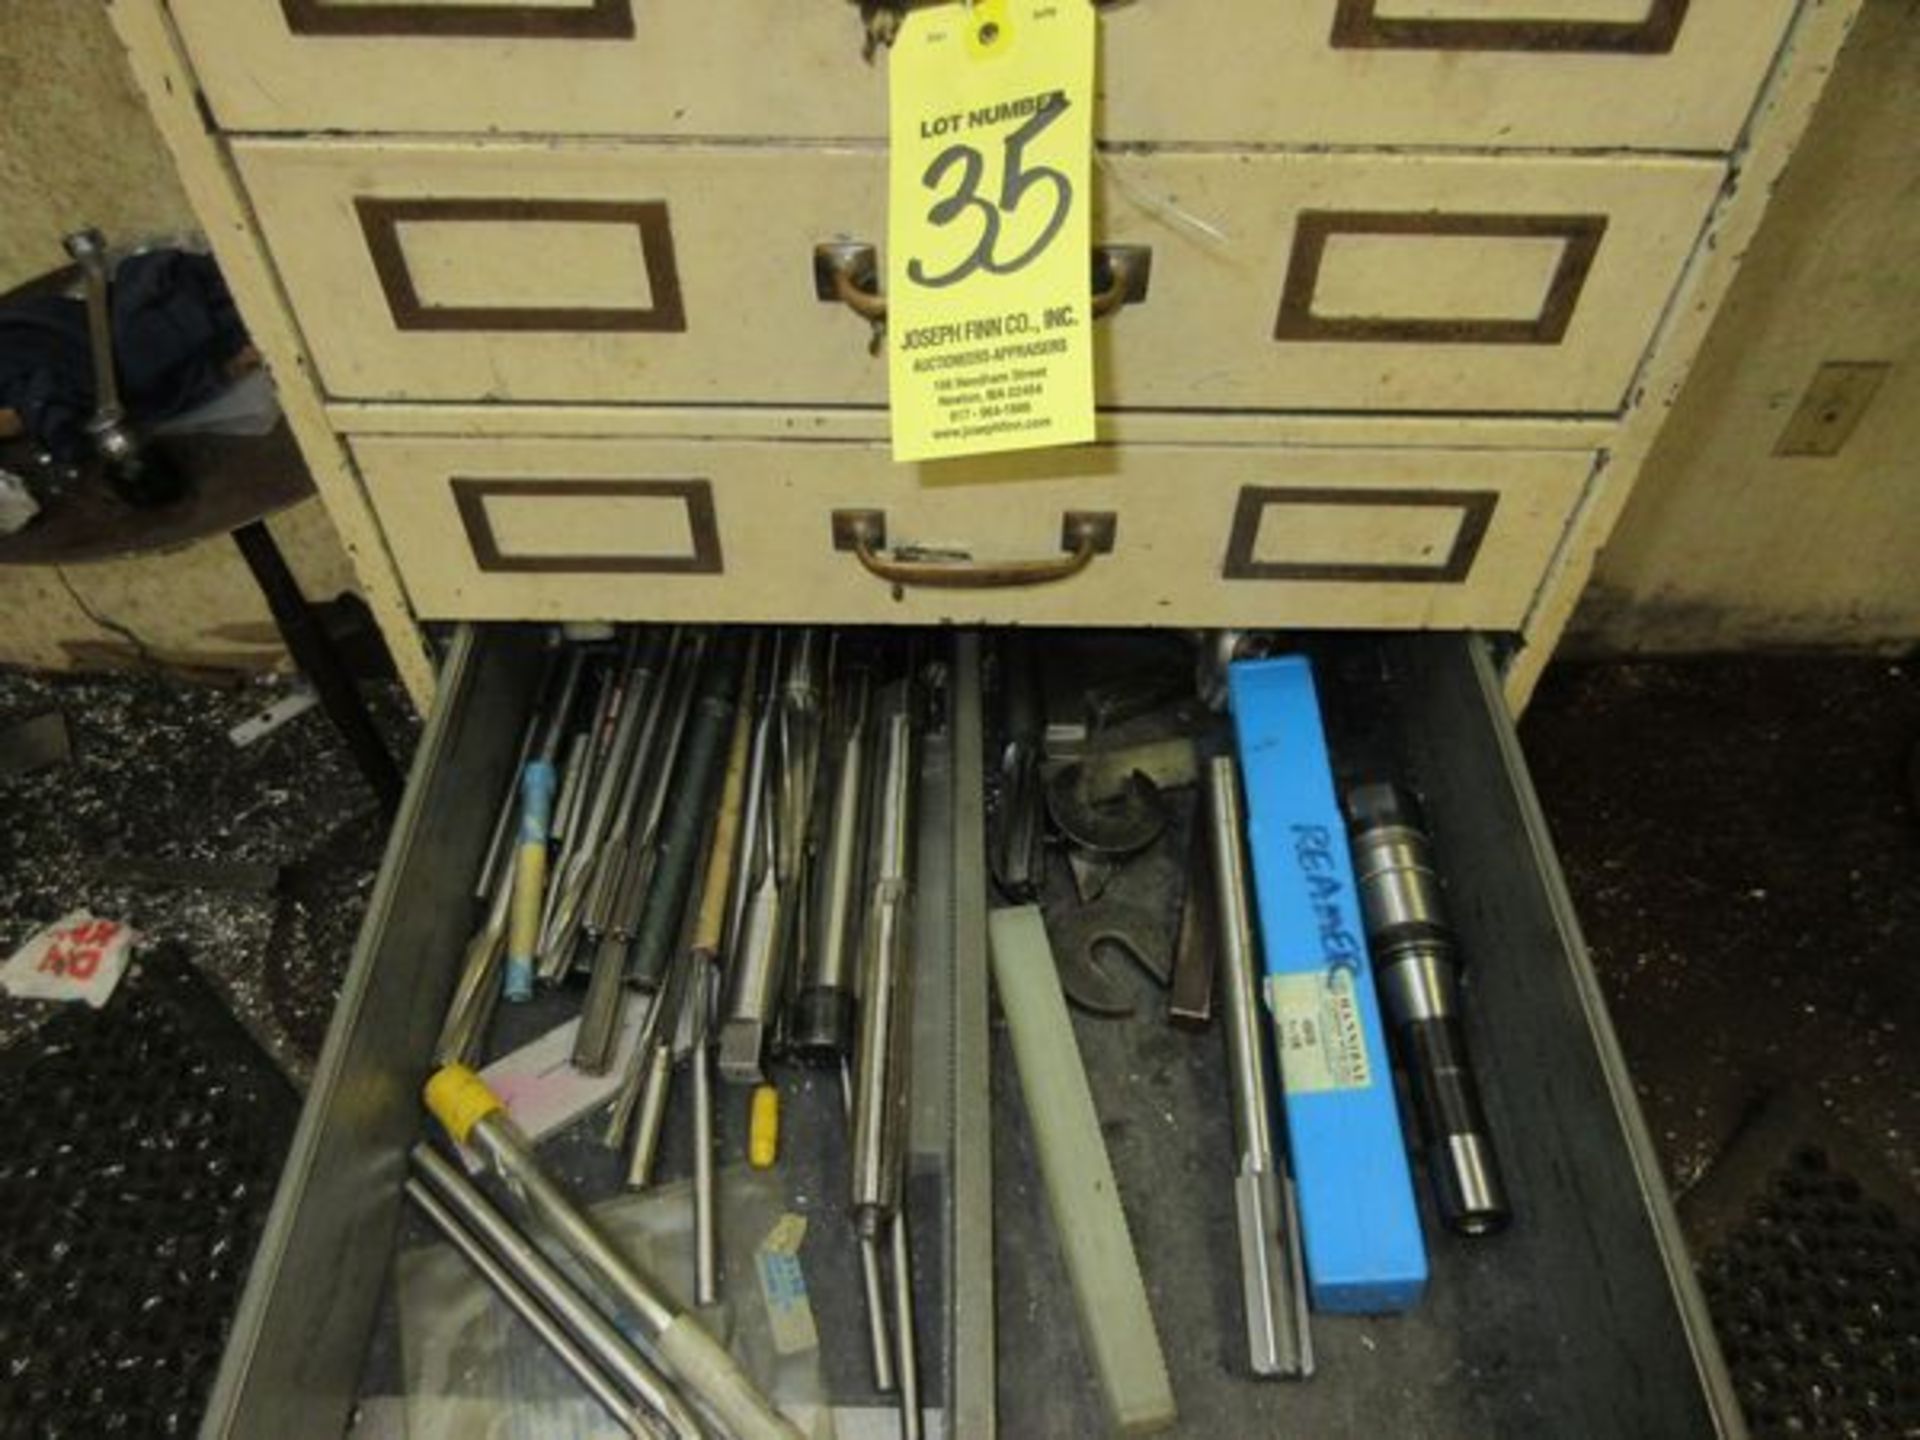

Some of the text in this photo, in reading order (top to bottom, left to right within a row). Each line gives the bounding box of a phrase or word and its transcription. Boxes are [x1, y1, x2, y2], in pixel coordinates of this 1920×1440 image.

[920, 114, 963, 139] LOT
[906, 94, 1073, 289] 35
[901, 305, 1079, 351] JOSEPH FINN CO., INC.
[1011, 367, 1048, 382] Street
[985, 388, 1005, 401] MA
[1288, 824, 1363, 990] REAMER
